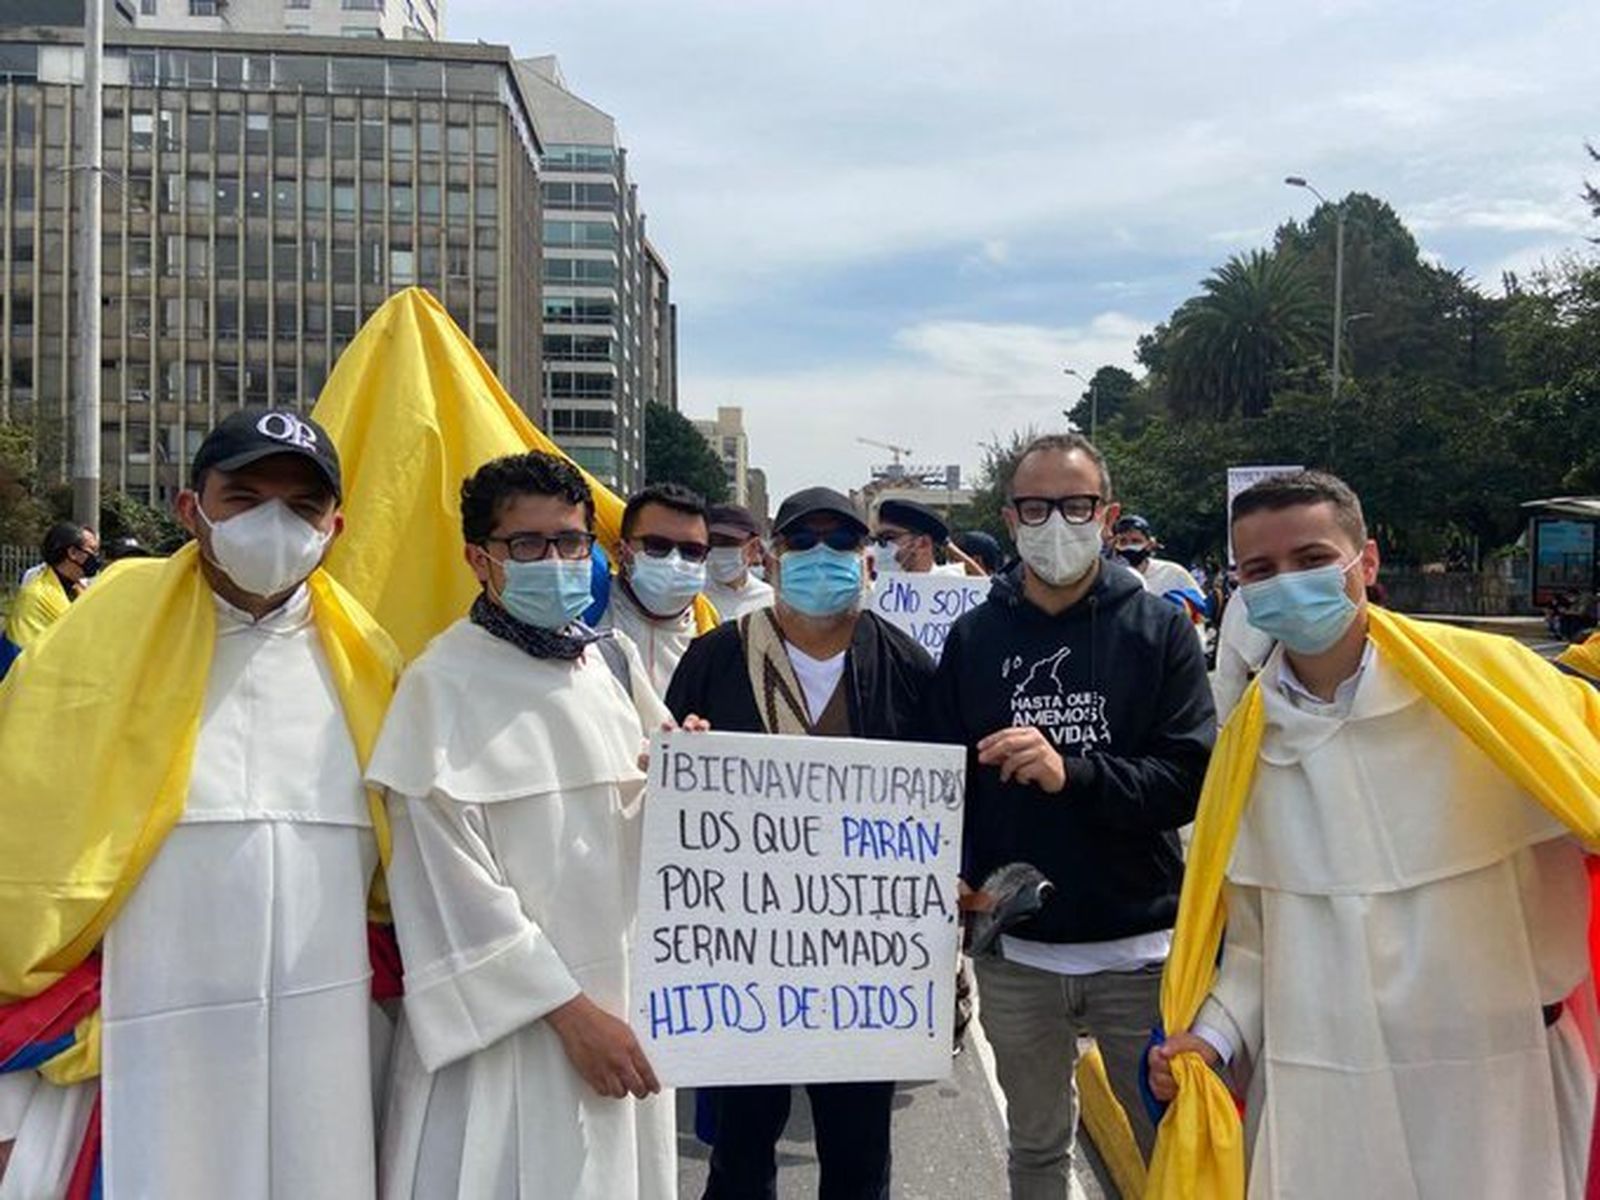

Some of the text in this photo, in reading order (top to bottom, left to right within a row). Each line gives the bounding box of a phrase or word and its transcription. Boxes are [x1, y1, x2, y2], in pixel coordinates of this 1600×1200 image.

[1011, 695, 1063, 710] HASTA
[1012, 708, 1098, 727] AMEMOS
[1048, 725, 1098, 744] VIDA
[679, 809, 741, 853] LOS
[753, 812, 822, 857] QUE
[657, 865, 725, 912] POR
[743, 872, 781, 915] LA
[653, 924, 930, 970] SERAN LLAMADOS
[649, 982, 766, 1039] HIJOS
[778, 984, 820, 1030] DE
